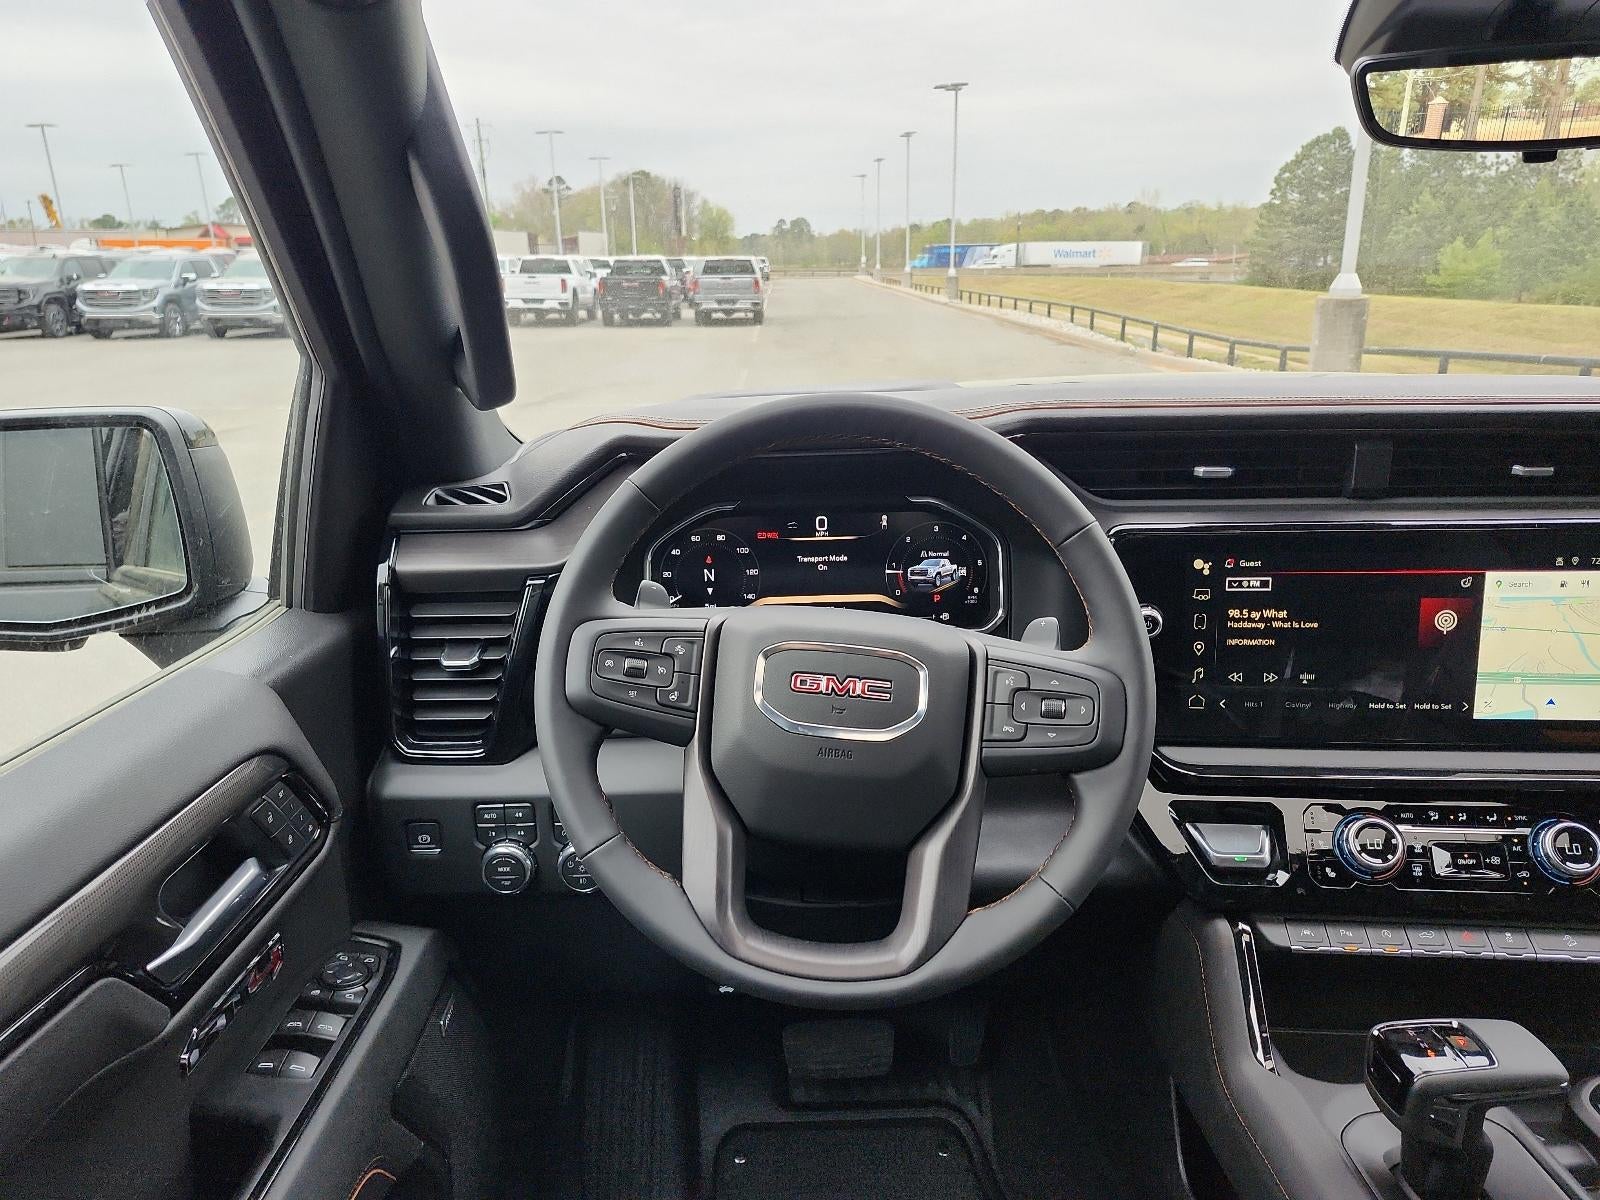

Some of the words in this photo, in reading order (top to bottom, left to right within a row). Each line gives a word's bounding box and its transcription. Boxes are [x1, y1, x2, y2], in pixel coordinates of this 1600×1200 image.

[1053, 248, 1096, 259] Walmart
[815, 516, 828, 530] 0
[797, 555, 828, 563] Transport
[704, 568, 714, 582] N
[1508, 580, 1534, 588] Search
[934, 594, 940, 602] P
[1228, 609, 1248, 618] 98.5
[1250, 611, 1261, 620] ay
[1262, 609, 1288, 618] What
[1227, 621, 1265, 630] Haddaway
[790, 671, 893, 702] GMC
[1328, 702, 1358, 710] Highway
[817, 747, 853, 760] AIRBAG
[1366, 838, 1382, 850] LO
[1564, 843, 1582, 854] LO
